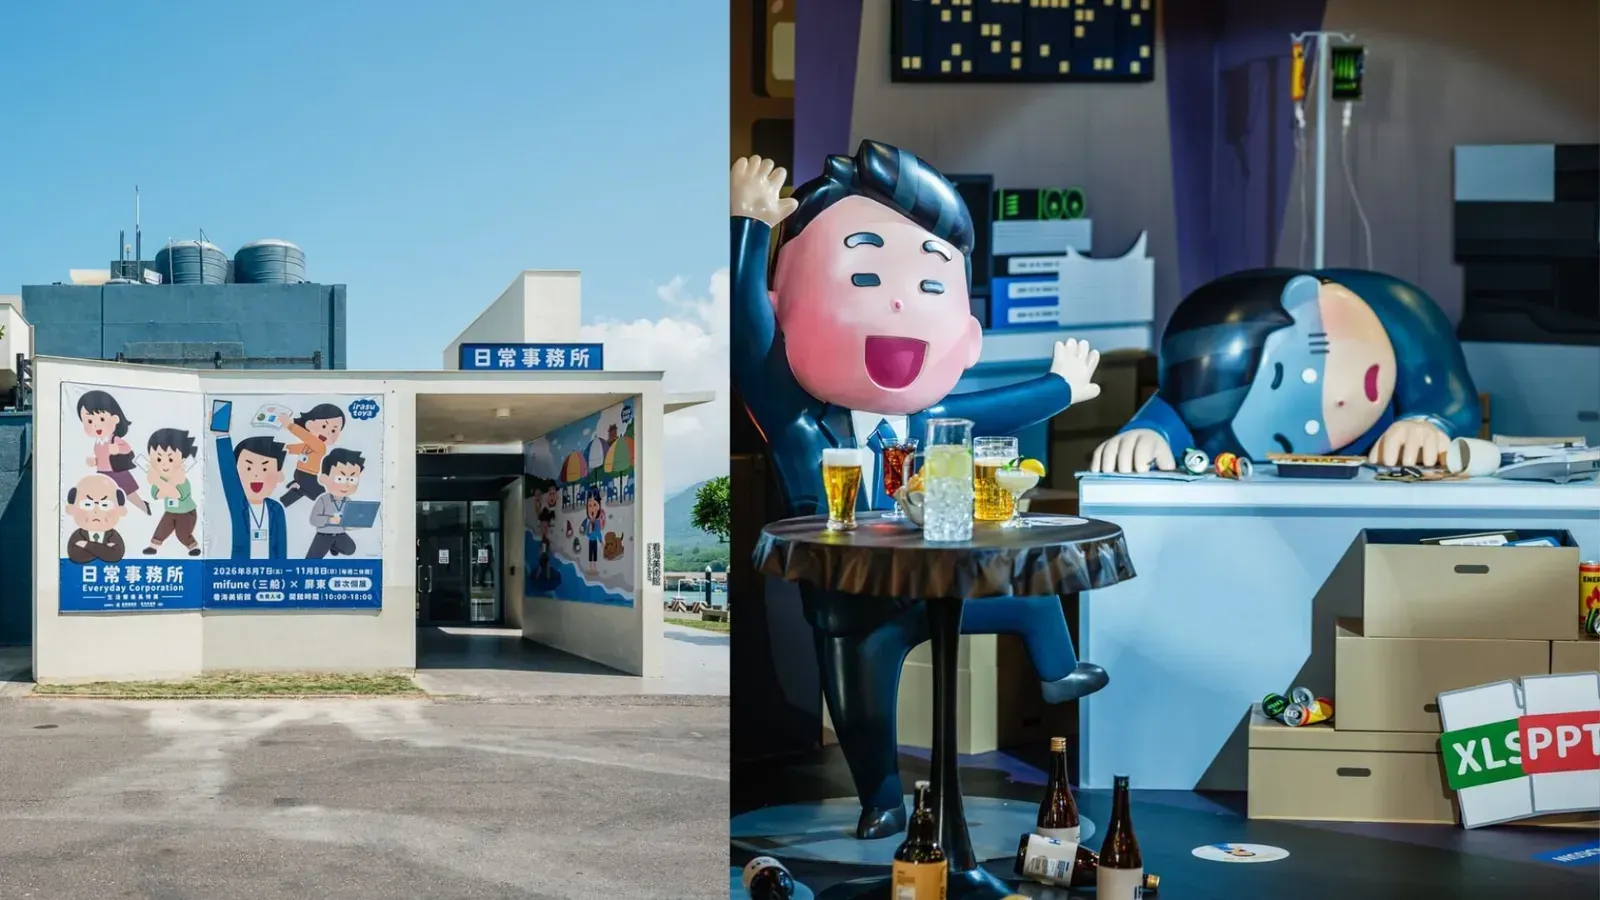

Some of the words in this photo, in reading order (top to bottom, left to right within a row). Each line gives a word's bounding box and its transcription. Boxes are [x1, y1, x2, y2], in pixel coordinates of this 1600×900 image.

[474, 347, 590, 368] 日常事務所
[352, 402, 376, 410] irasu
[82, 565, 184, 584] 日常事務所
[213, 579, 250, 589] mifune
[304, 579, 327, 589] 屏東
[334, 580, 367, 588] 首次個展
[82, 584, 126, 593] Everyday
[129, 584, 184, 592] Corporation
[1527, 723, 1600, 760] PPT
[1452, 730, 1522, 776] XLS
